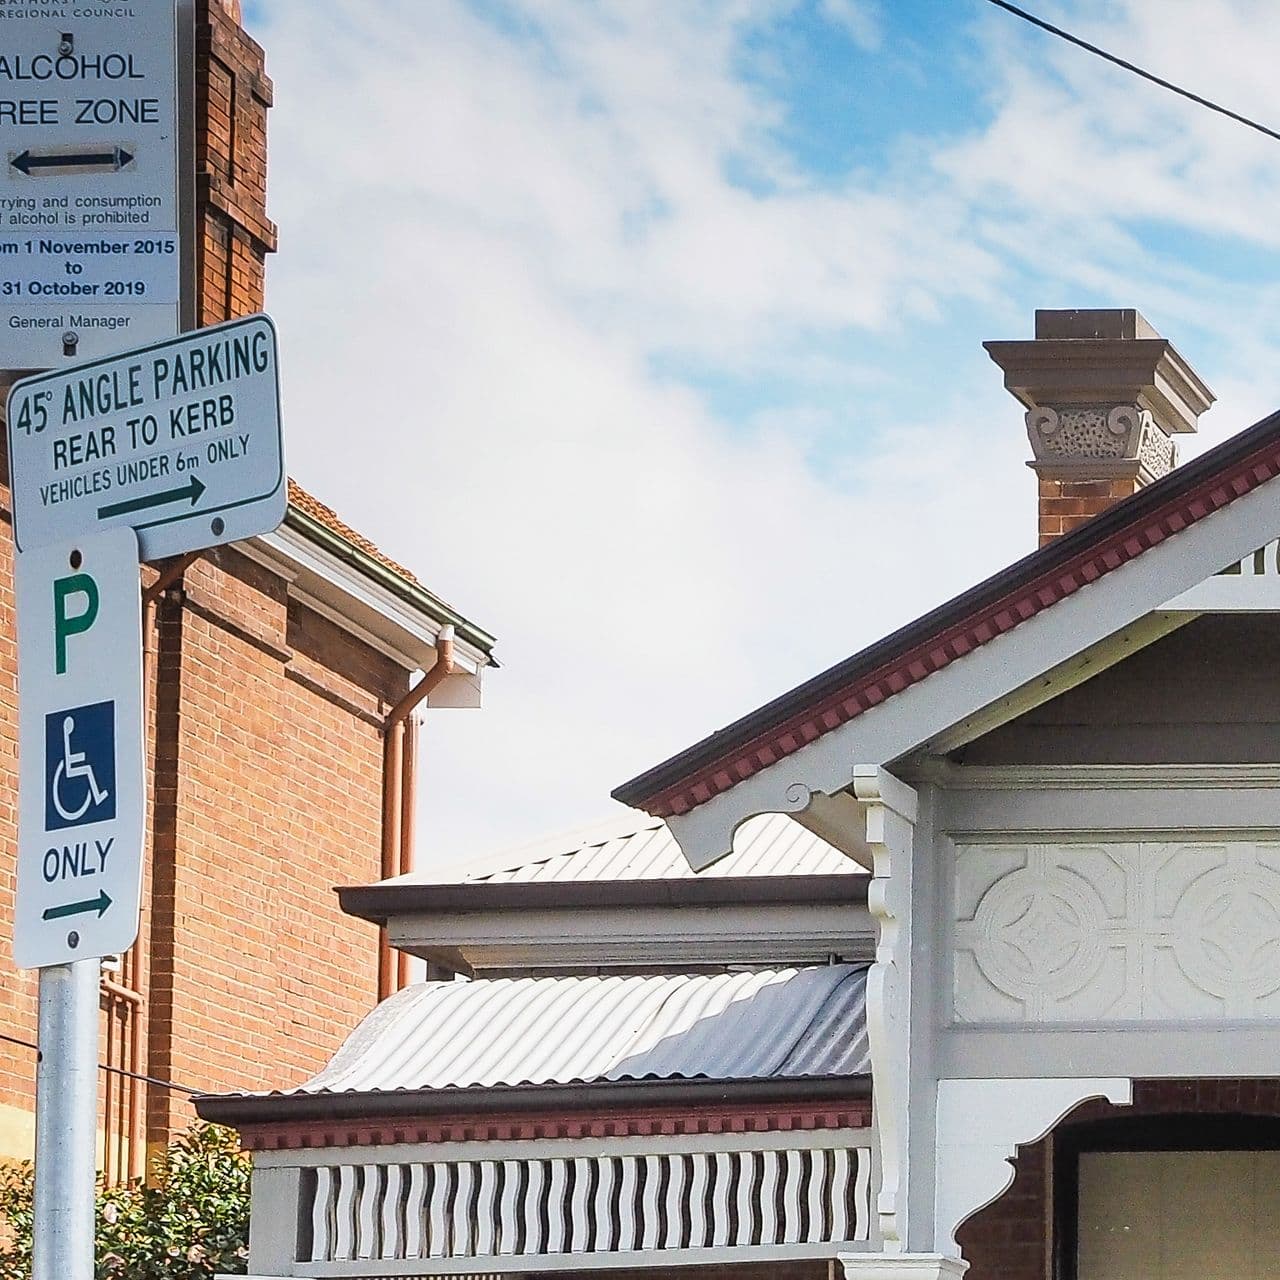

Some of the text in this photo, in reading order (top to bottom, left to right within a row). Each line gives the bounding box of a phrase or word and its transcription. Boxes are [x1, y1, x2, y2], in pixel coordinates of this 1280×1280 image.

[0, 8, 135, 18] REGIONAL COUNCIL
[0, 54, 145, 79] ALCOHOL
[75, 98, 159, 124] ZONE
[43, 196, 68, 208] and
[75, 194, 161, 209] consumption
[9, 212, 58, 225] alcohol
[65, 212, 76, 224] is
[83, 211, 149, 226] prohibited
[25, 241, 32, 254] 1
[40, 240, 129, 254] November
[134, 240, 175, 254] 2015
[65, 261, 83, 274] to
[2, 281, 145, 295] 31 October 2019
[9, 315, 130, 329] General Manager
[62, 365, 144, 424] ANGLE
[153, 331, 268, 400] PARKING
[53, 394, 234, 470] REAR TO KERB
[39, 433, 250, 506] VEHICLES UNDER 6m ONLY
[53, 573, 99, 675] P
[42, 838, 115, 883] ONLY
